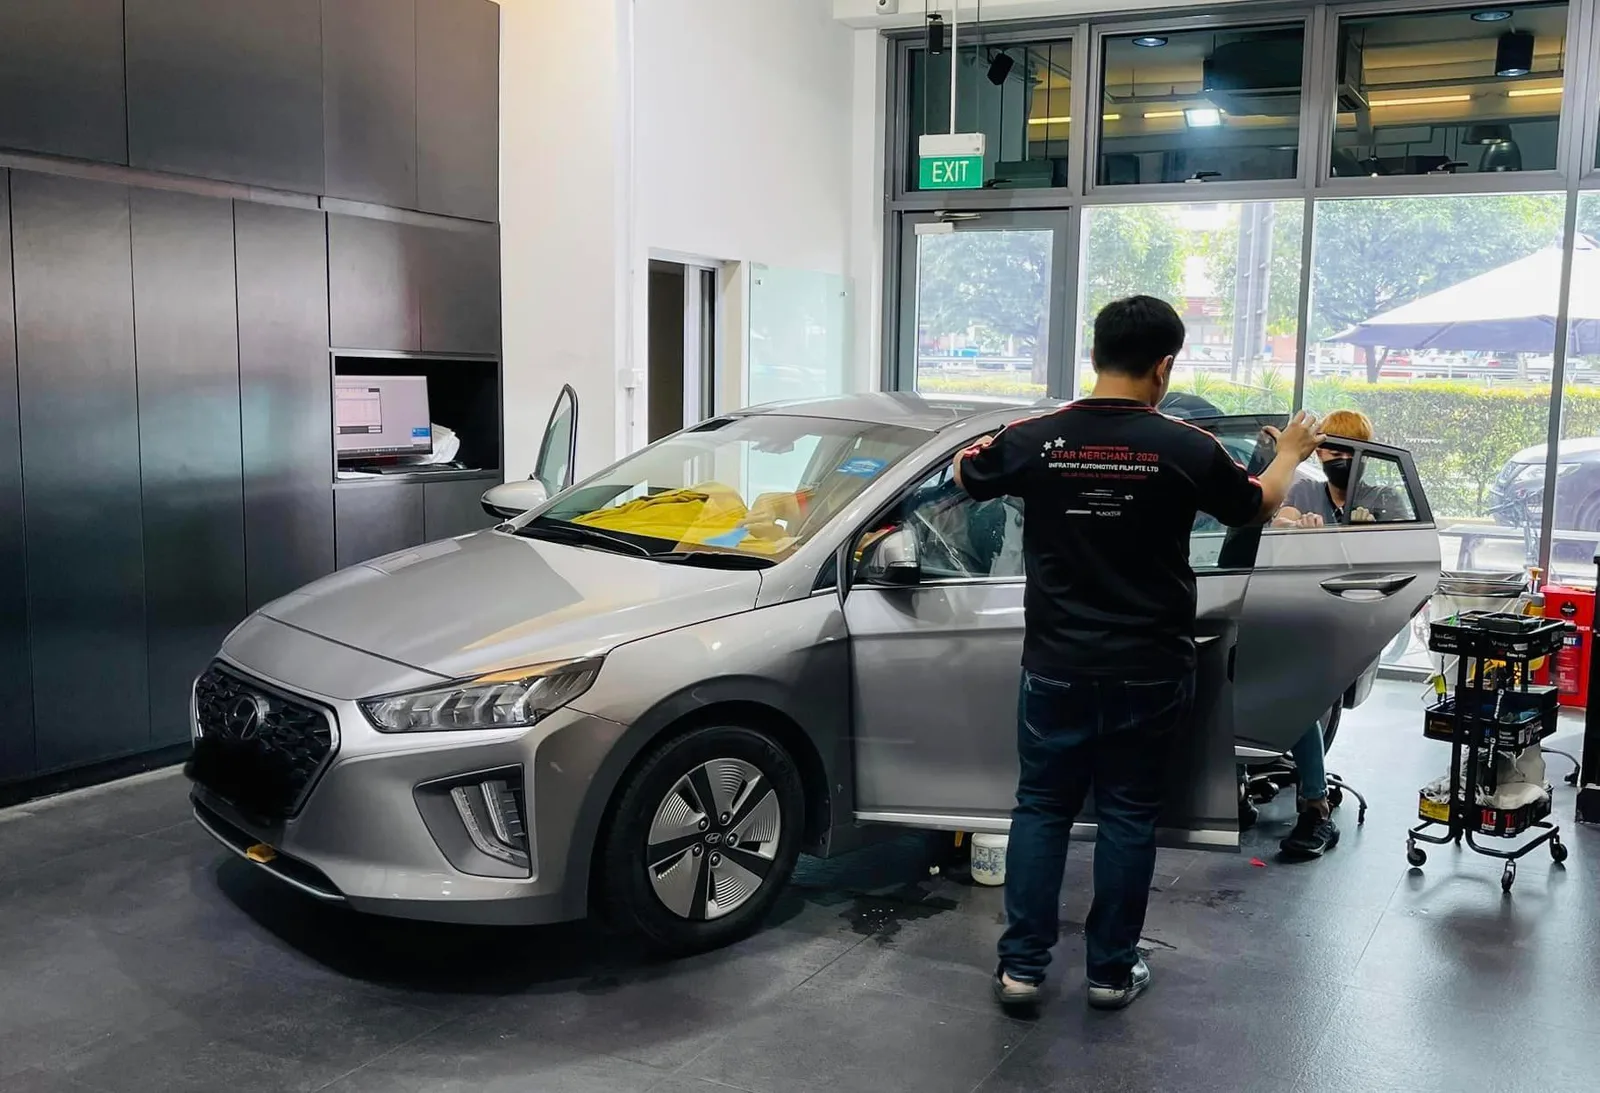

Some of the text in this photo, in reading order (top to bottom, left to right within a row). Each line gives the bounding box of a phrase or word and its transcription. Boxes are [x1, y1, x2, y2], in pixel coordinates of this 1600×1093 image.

[932, 160, 970, 183] EXIT
[1051, 450, 1159, 462] STAR MERCHANT 2020
[1080, 463, 1118, 471] AUTOMOTIVE
